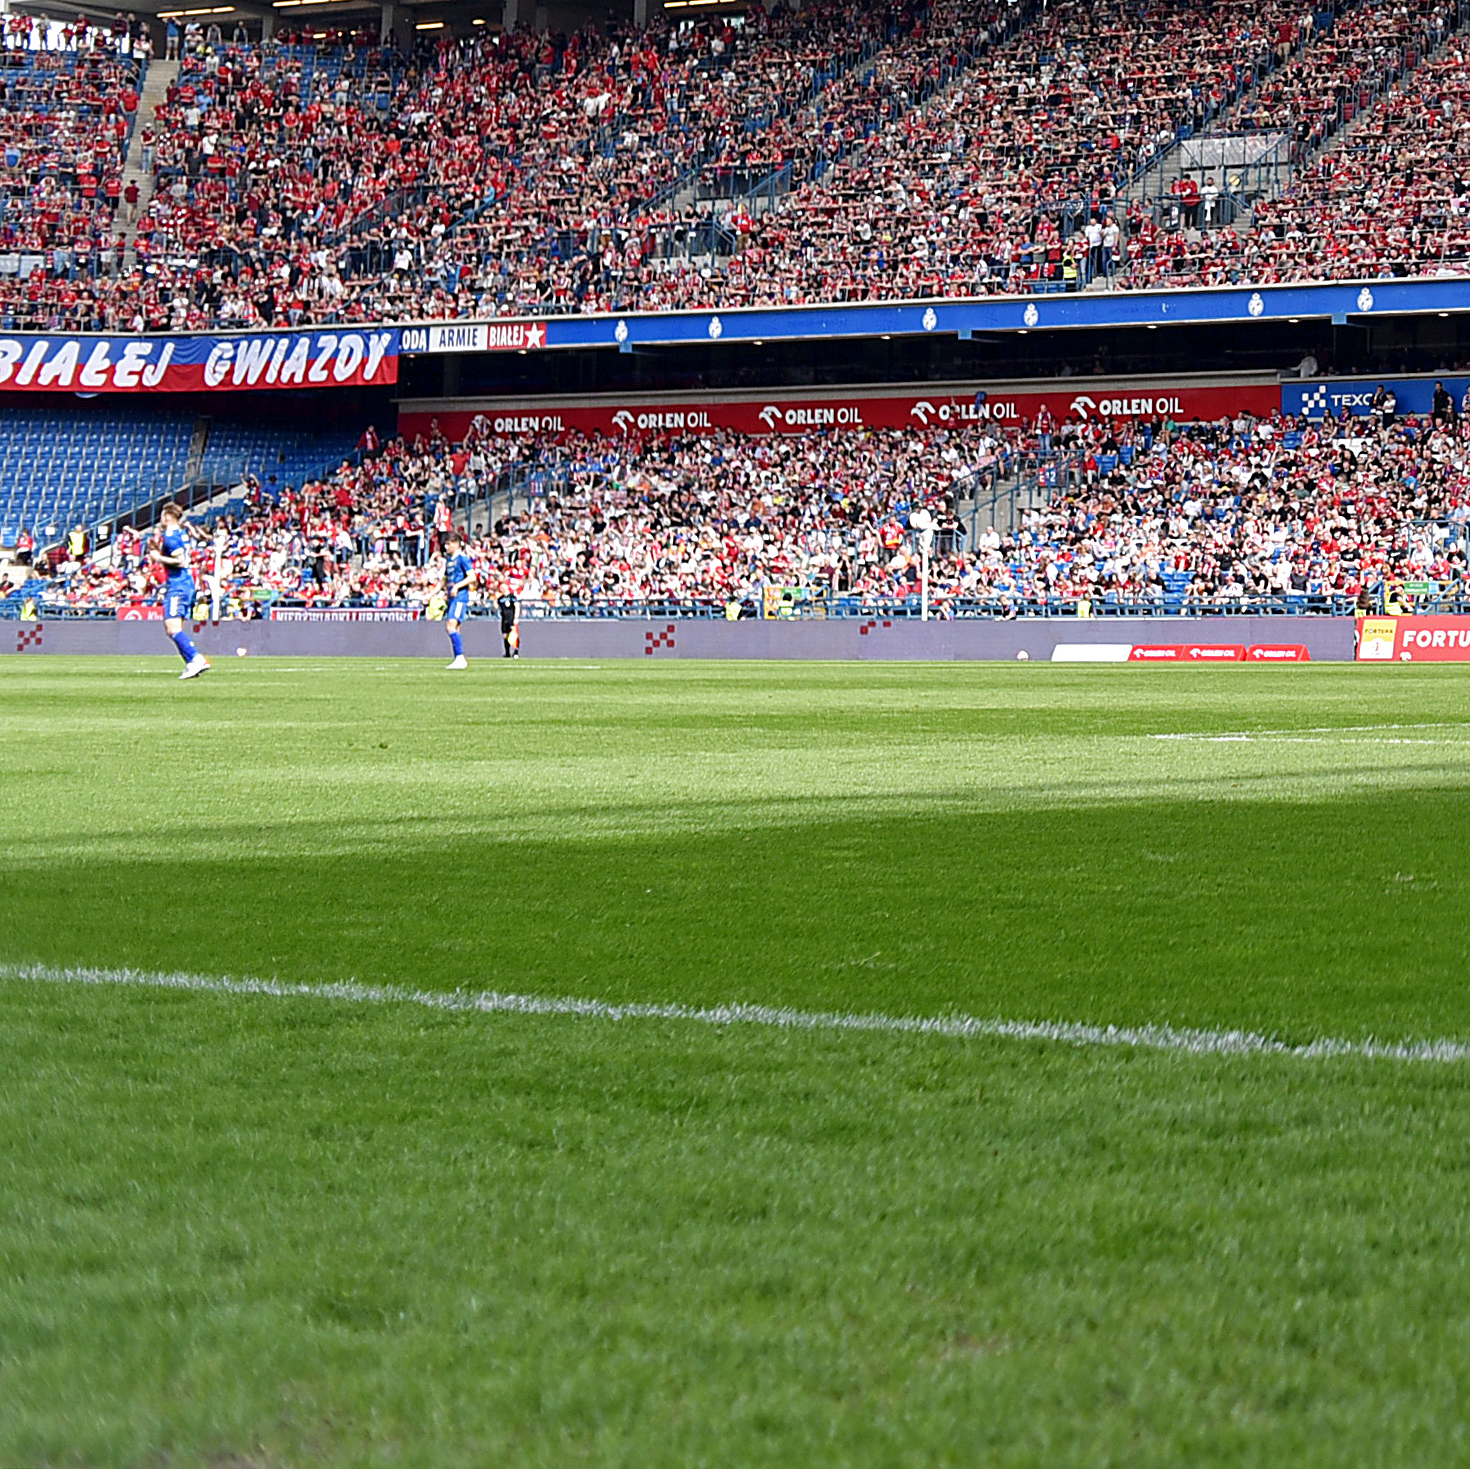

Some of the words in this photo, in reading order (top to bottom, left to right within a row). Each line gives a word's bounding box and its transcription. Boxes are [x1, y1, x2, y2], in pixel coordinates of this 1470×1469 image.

[204, 333, 392, 387] GWIAZDY
[939, 404, 990, 420] OLEN
[993, 402, 1019, 419] OIL
[1100, 399, 1153, 415] ORLEN
[1156, 397, 1184, 414] OIL
[494, 417, 539, 433] ORLEN
[541, 415, 565, 431] OIL
[637, 413, 685, 430] ORLEN
[687, 412, 711, 428] OIL
[785, 409, 834, 425] ORLEN
[837, 407, 863, 423] OIL
